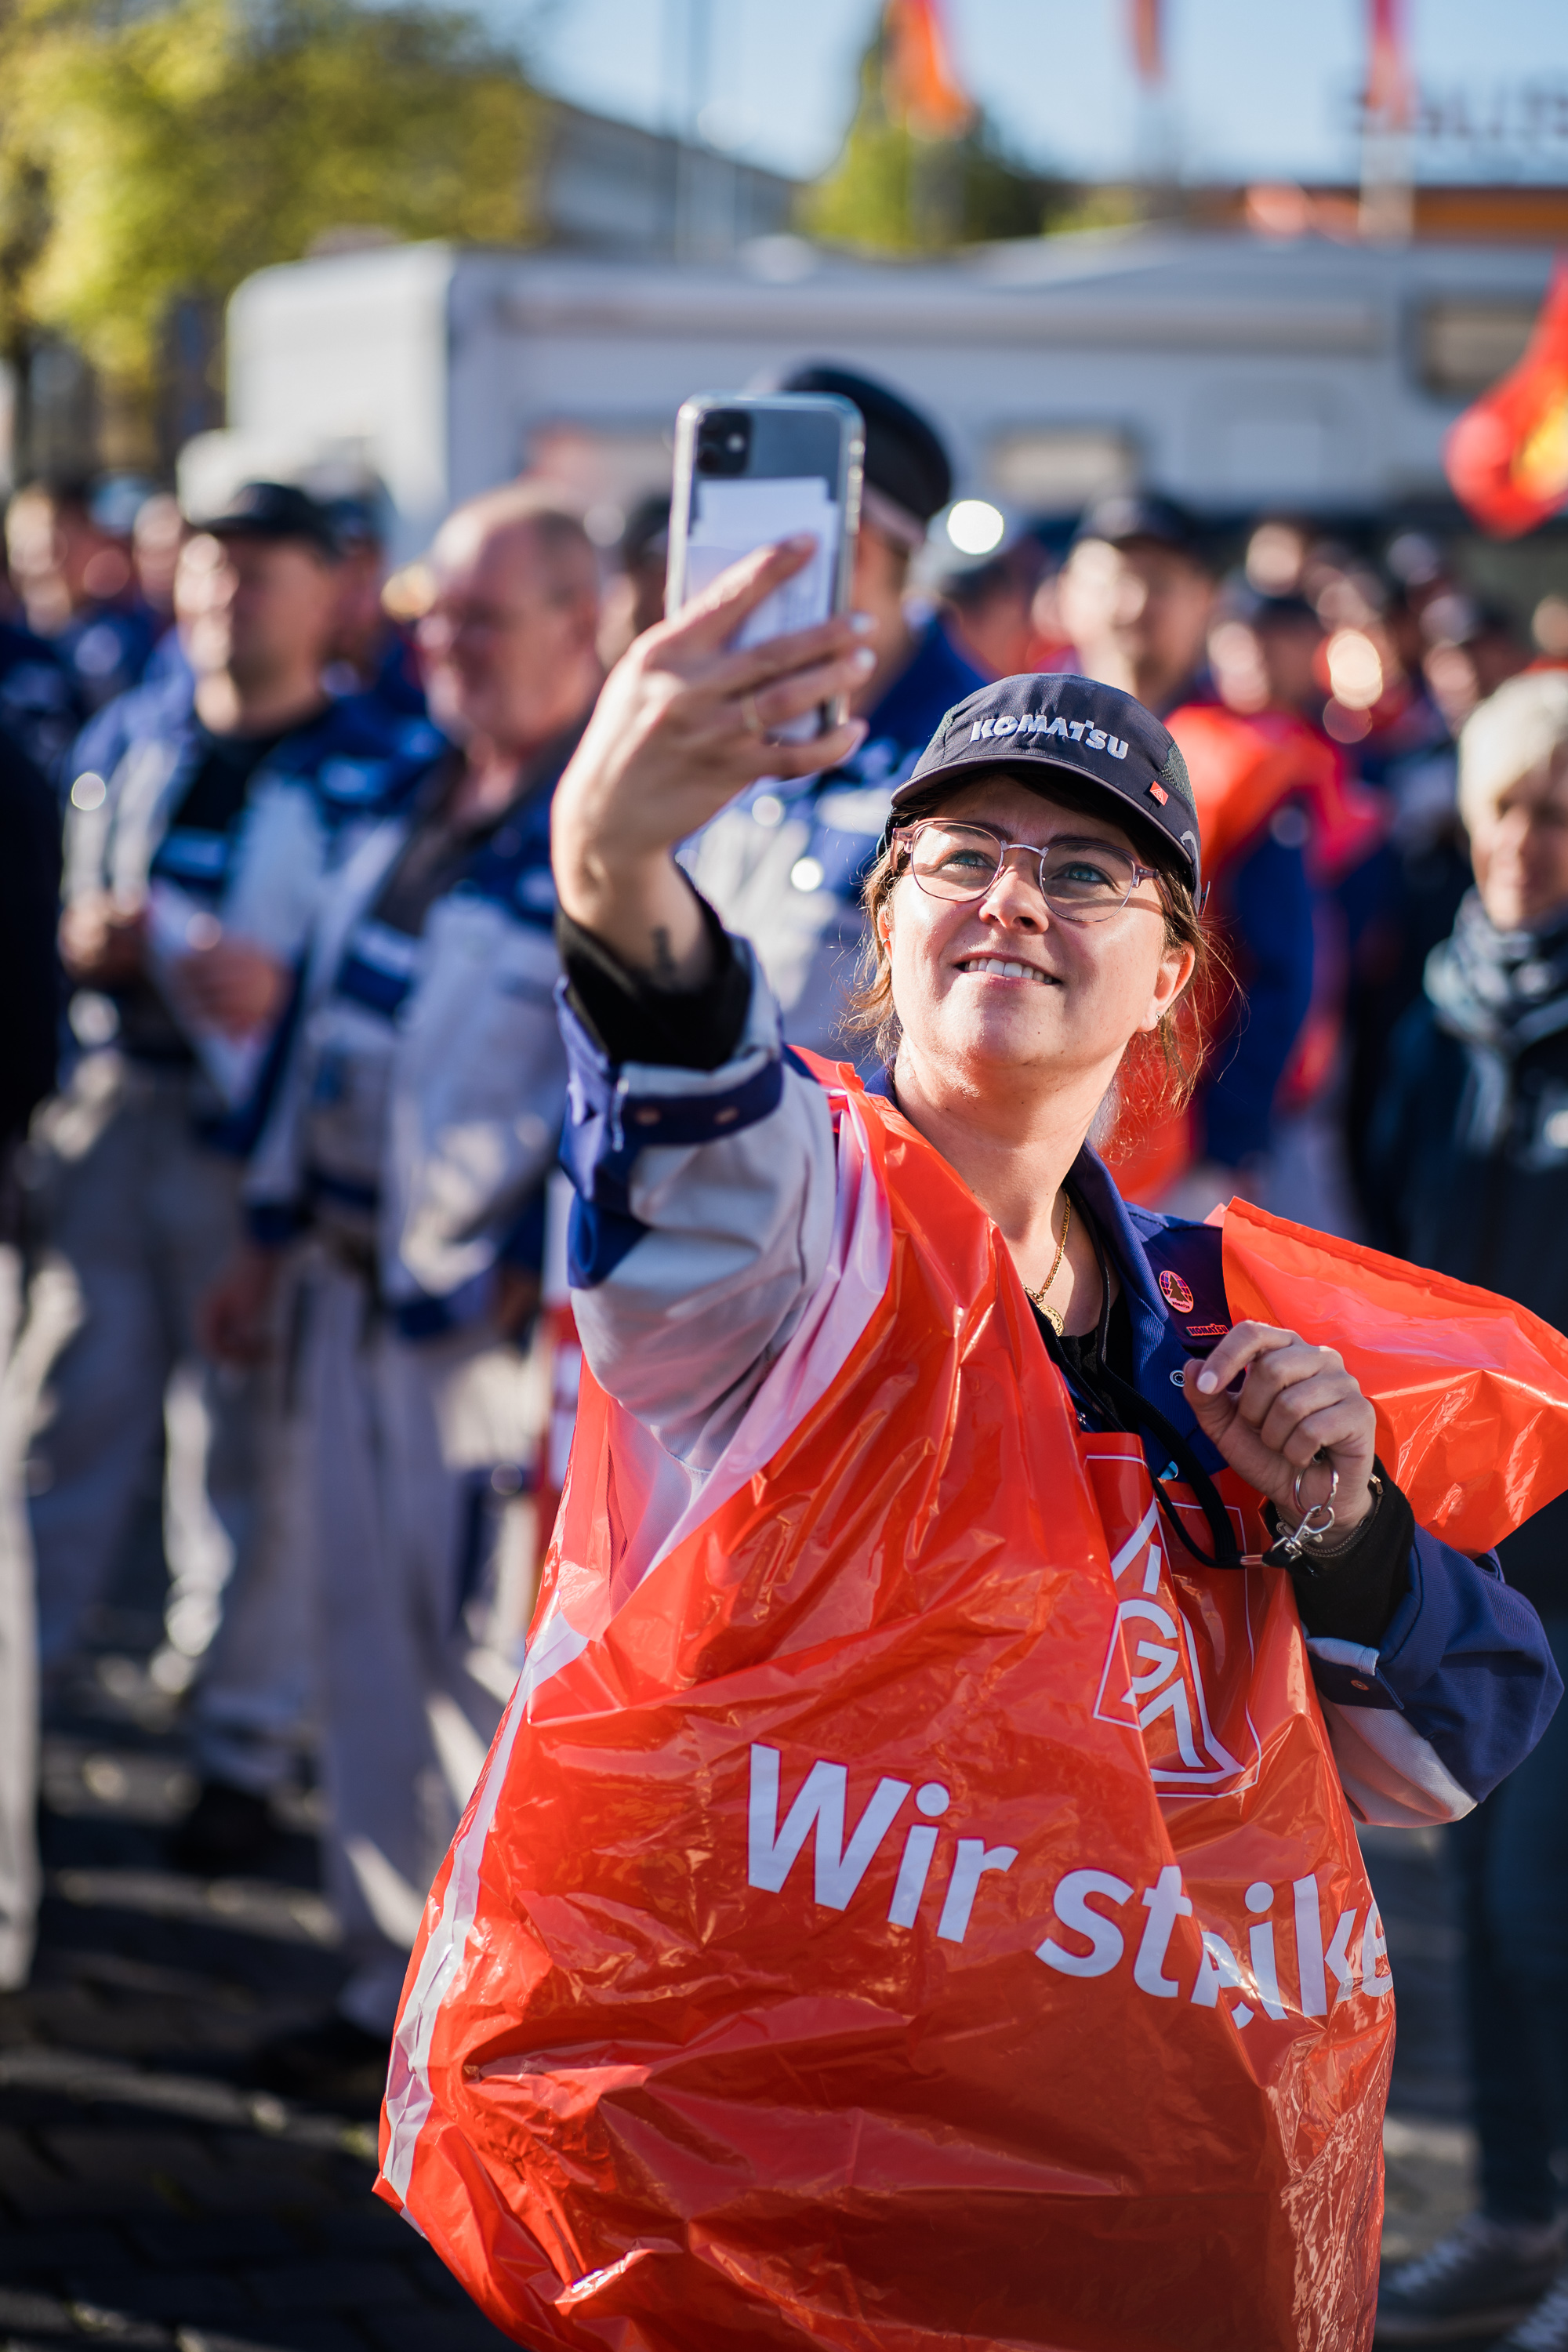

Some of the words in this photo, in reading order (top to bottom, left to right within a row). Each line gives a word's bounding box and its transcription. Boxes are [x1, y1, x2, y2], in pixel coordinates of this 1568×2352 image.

[971, 715, 1129, 759] KOMATSU
[1188, 1324, 1229, 1334] KOMATSU
[748, 1743, 1018, 1943] Wir
